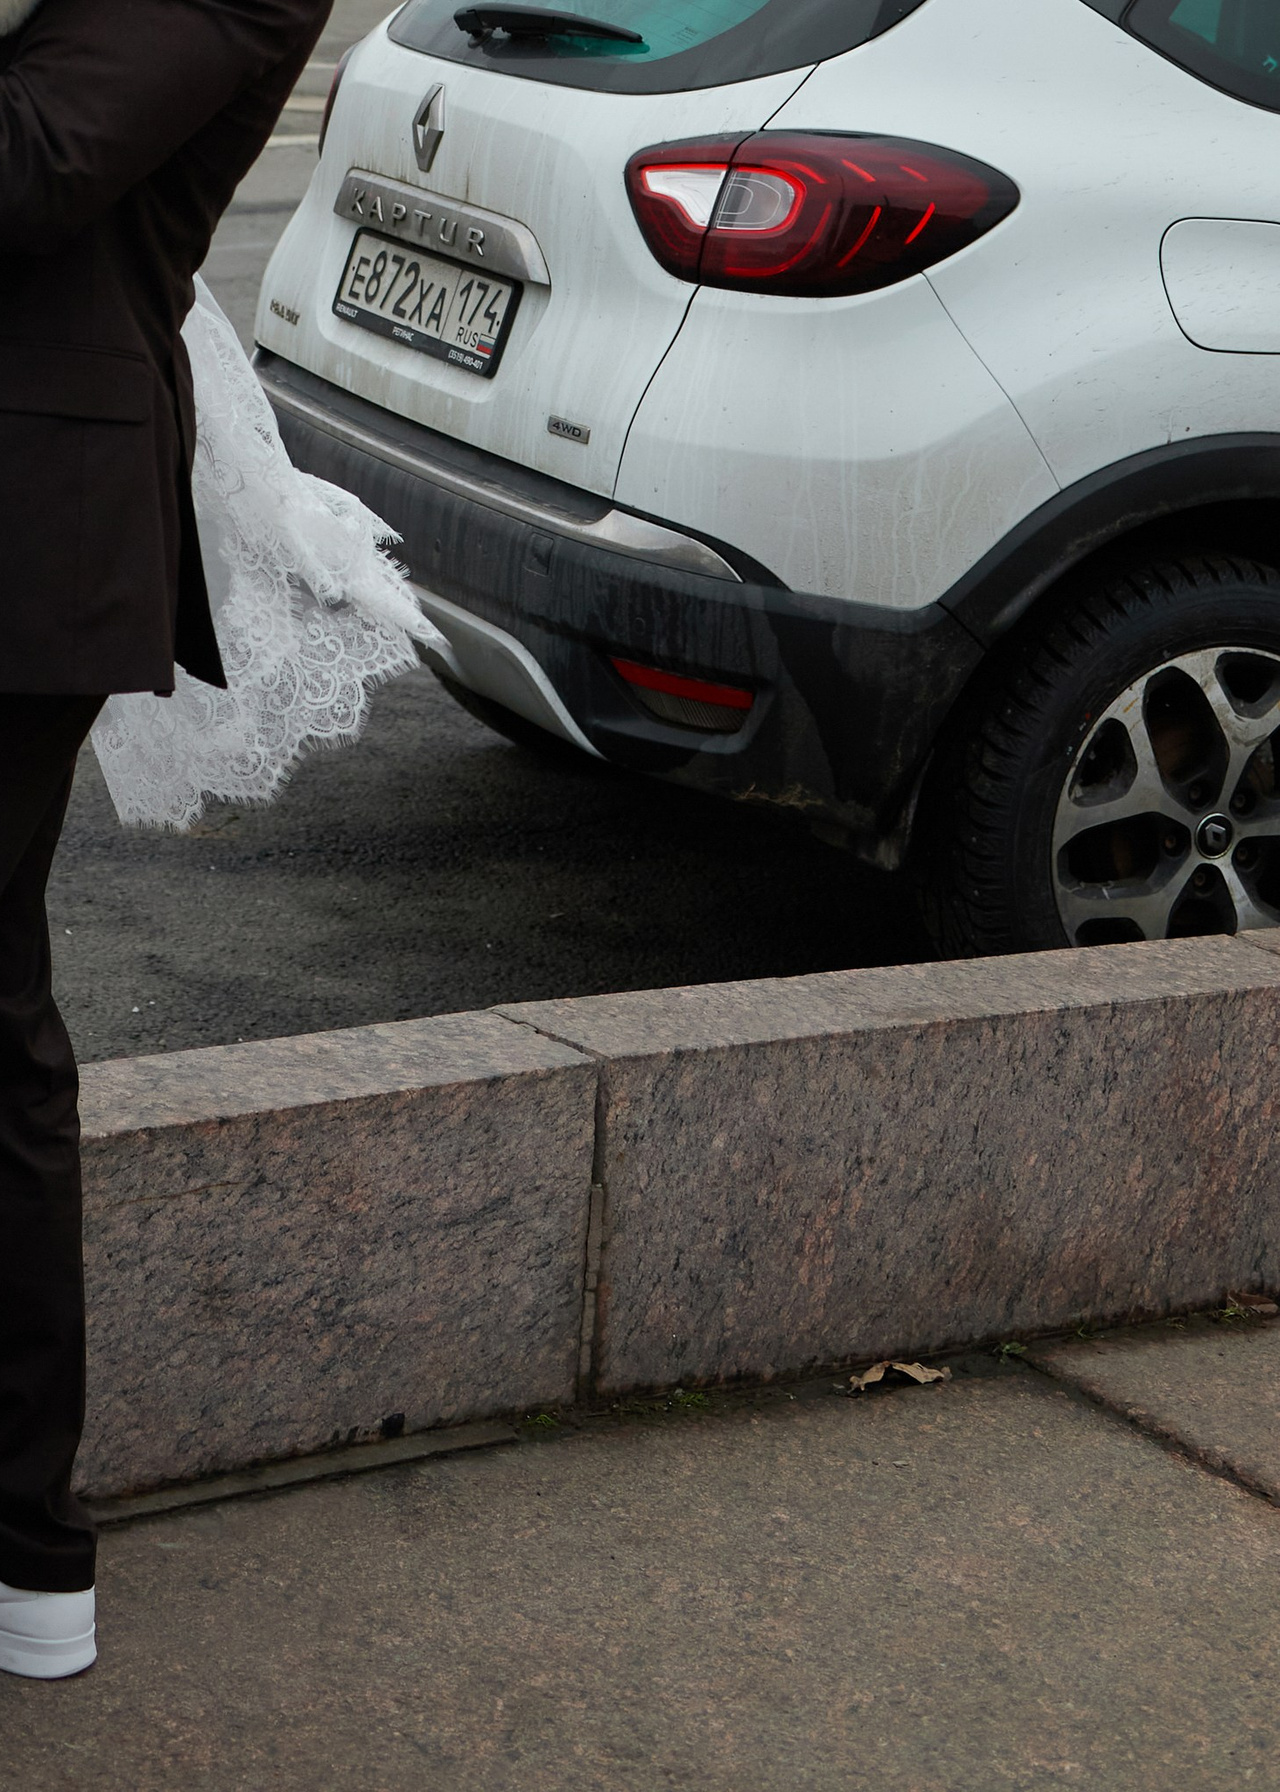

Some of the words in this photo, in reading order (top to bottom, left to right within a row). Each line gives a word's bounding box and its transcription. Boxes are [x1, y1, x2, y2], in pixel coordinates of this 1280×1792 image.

[350, 187, 486, 257] KAPTUR
[348, 250, 447, 332] Е872ХА
[458, 278, 503, 334] 174
[335, 302, 359, 318] RENAULT
[391, 326, 415, 342] РЕГИНАС
[455, 326, 478, 348] RUS
[551, 421, 582, 438] 4WD
